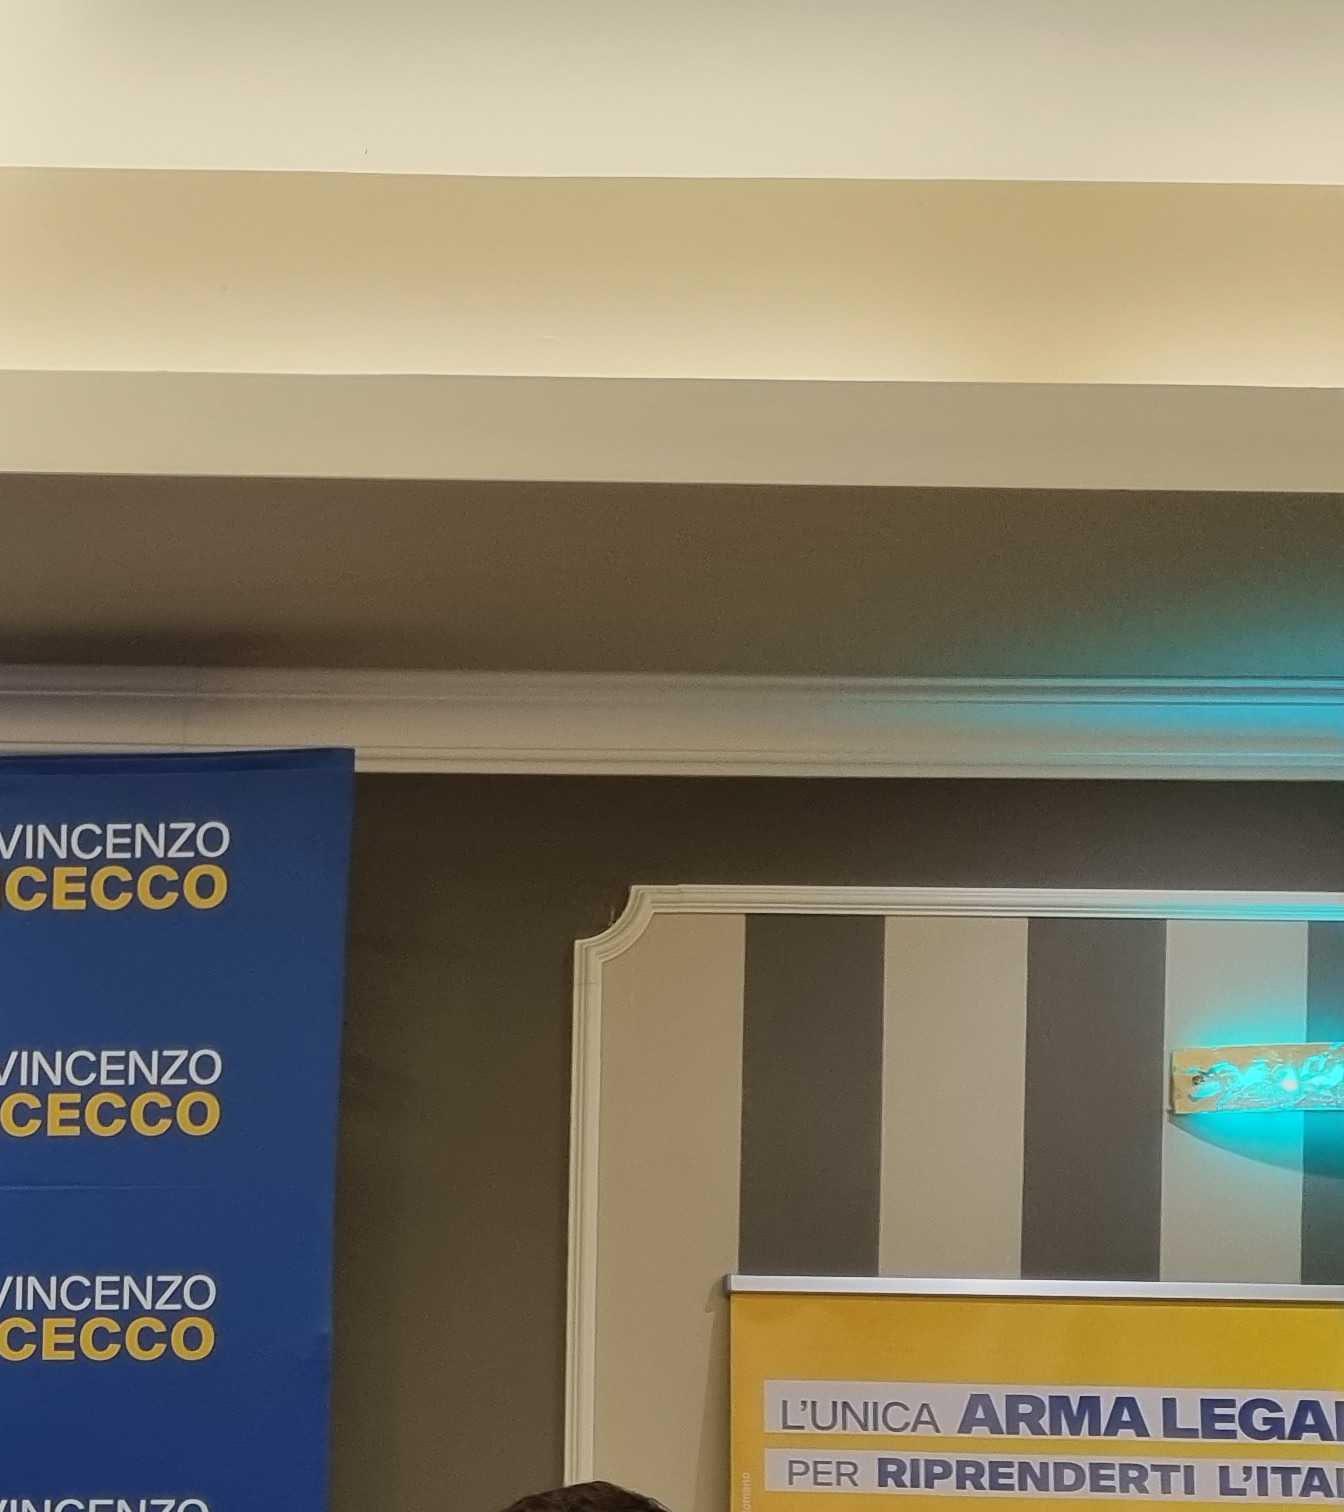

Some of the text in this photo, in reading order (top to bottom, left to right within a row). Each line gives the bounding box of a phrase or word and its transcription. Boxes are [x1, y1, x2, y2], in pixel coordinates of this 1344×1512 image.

[781, 1393, 1344, 1442] L'UNICA ARMA LEGA
[788, 1459, 860, 1487] PER
[877, 1457, 1196, 1496] RIPRENDERTI
